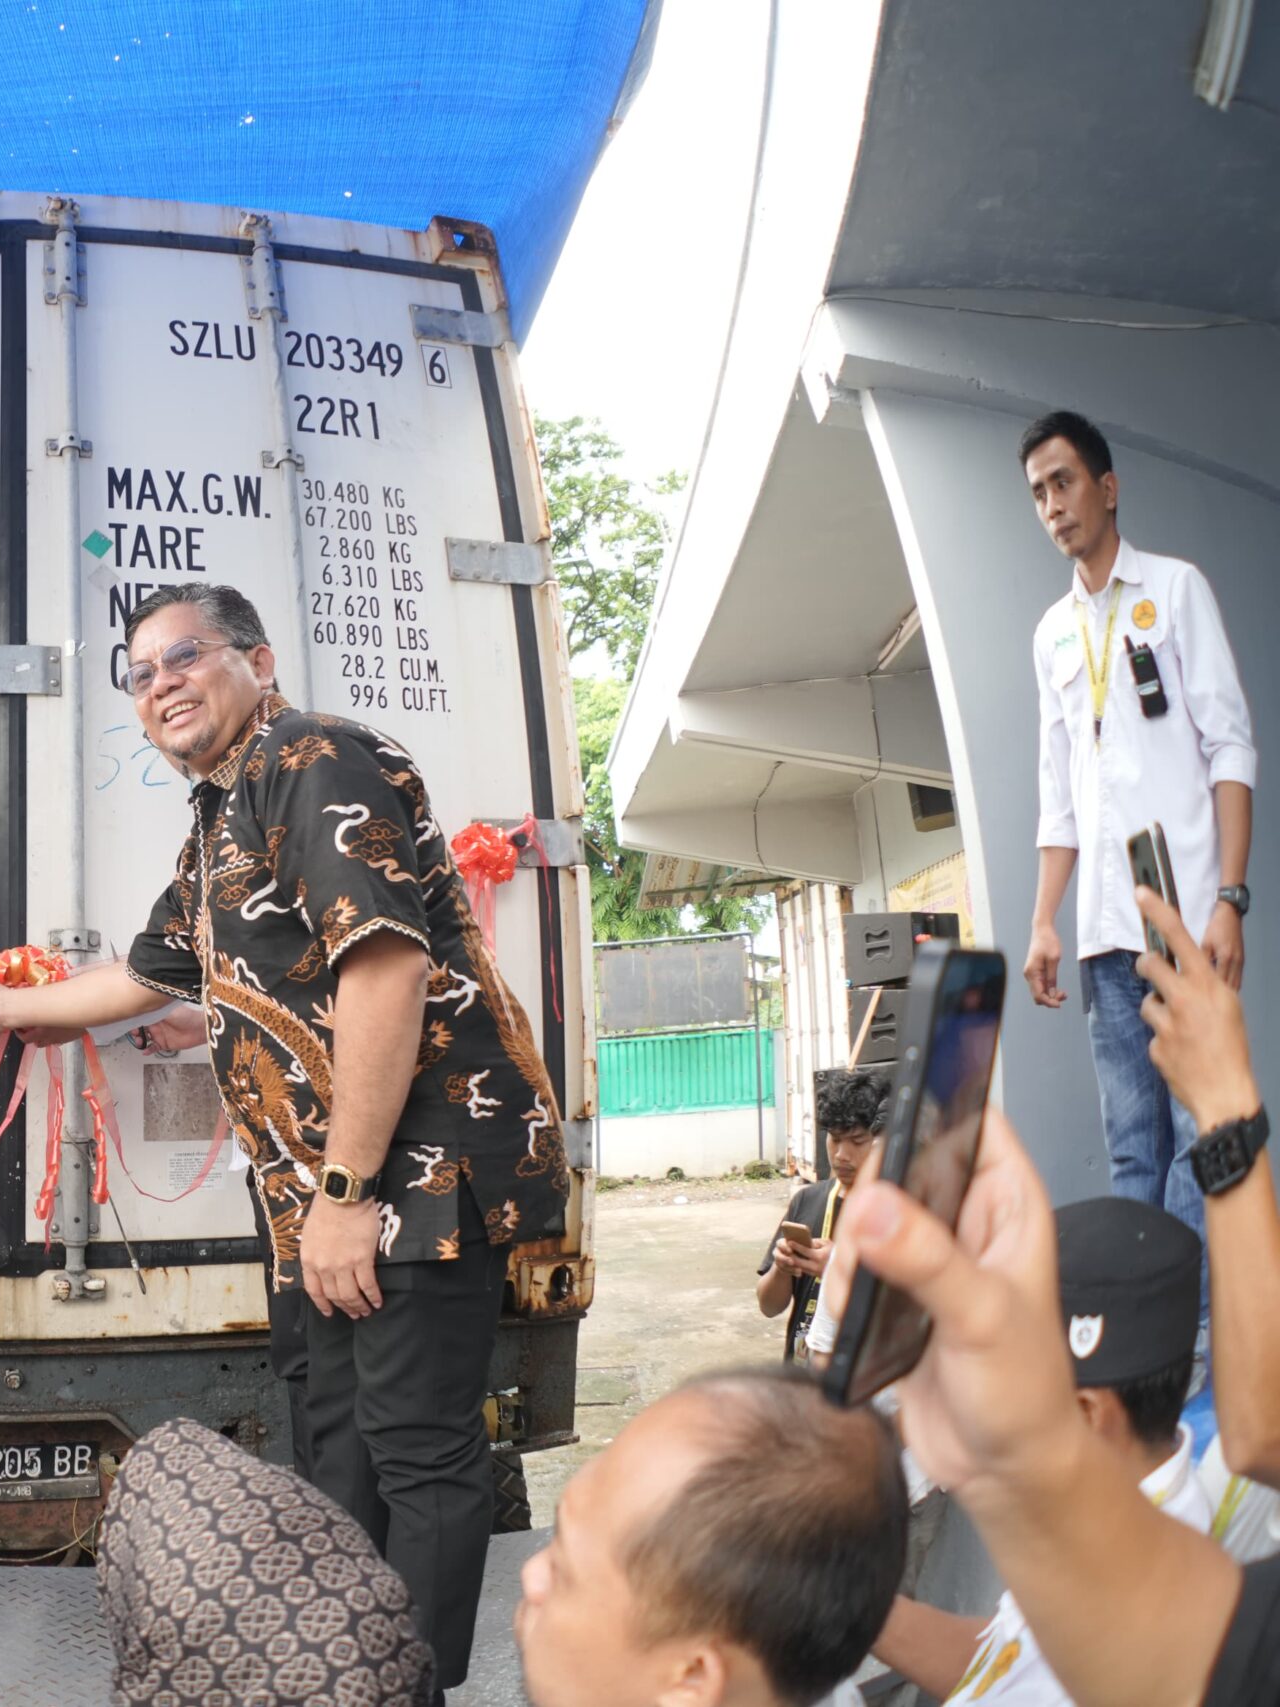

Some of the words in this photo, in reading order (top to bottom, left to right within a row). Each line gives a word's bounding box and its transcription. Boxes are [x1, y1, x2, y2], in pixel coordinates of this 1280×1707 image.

[168, 319, 257, 362] SZLU
[284, 330, 404, 378] 203349
[428, 350, 447, 385] 6
[293, 393, 381, 440] 22R1
[106, 466, 272, 519] MAX.G.W.
[382, 485, 406, 509] KG
[385, 512, 418, 536] LBS
[107, 522, 206, 572] TARE
[388, 541, 412, 564] KG
[391, 568, 424, 592] LBS
[394, 598, 418, 622] KG
[396, 626, 430, 651] LBS
[340, 654, 386, 680] 28.2
[399, 657, 445, 684] CU.M.
[350, 684, 388, 709] 996
[402, 687, 452, 714] CU.FT.
[53, 1444, 92, 1477] BB
